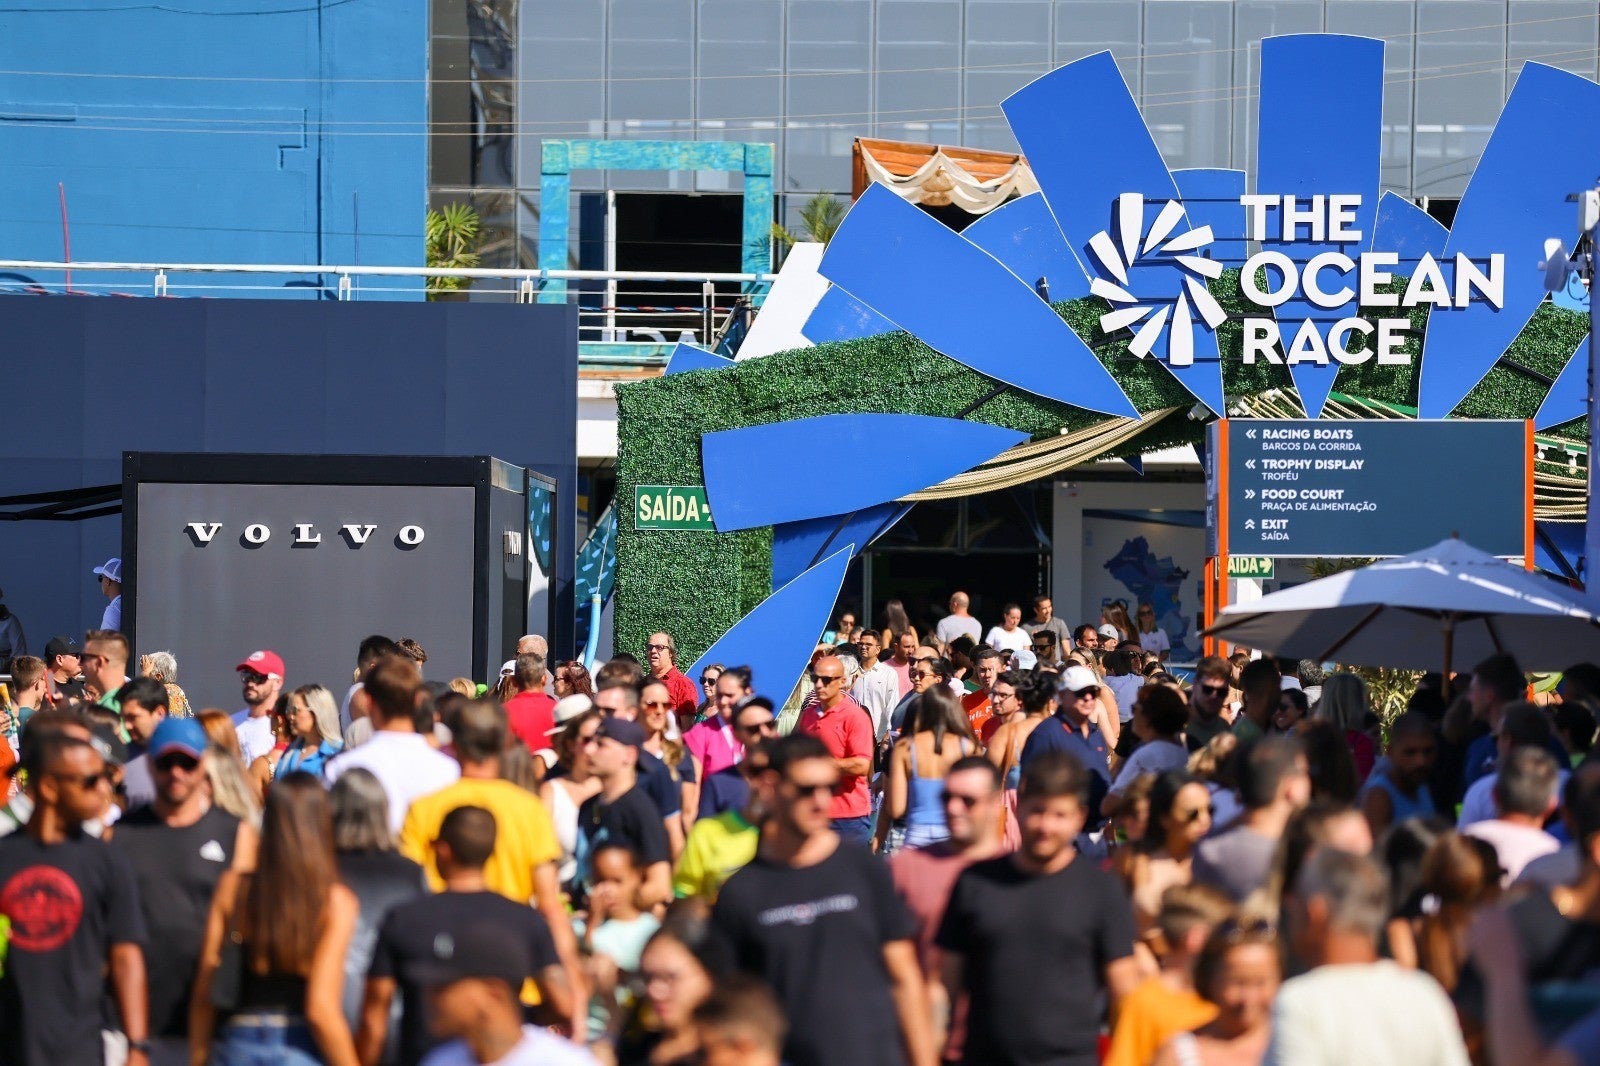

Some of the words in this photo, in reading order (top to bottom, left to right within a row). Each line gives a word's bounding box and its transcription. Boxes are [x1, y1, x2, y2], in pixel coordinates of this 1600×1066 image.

[1240, 194, 1362, 241] THE
[1240, 251, 1505, 308] OCEAN
[1242, 318, 1412, 366] RACE
[1263, 429, 1310, 439] RACING
[1313, 429, 1353, 439] BOATS
[1262, 442, 1300, 451] BARCOS
[1303, 442, 1316, 451] DA
[1318, 442, 1361, 451] CORRIDA
[1262, 459, 1312, 469] TROPHY
[1314, 459, 1364, 469] DISPLAY
[1262, 471, 1298, 480] TROFÉU
[1262, 489, 1297, 499] FOOD
[1300, 489, 1344, 499] COURT
[639, 488, 699, 522] SAÍDA
[1261, 502, 1293, 512] PRAÇA
[1295, 502, 1307, 511] DE
[1309, 501, 1377, 512] ALIMENTAÇÃO
[1262, 519, 1288, 529] EXIT
[187, 522, 425, 545] VOLVO
[1261, 531, 1290, 540] SAÍDA
